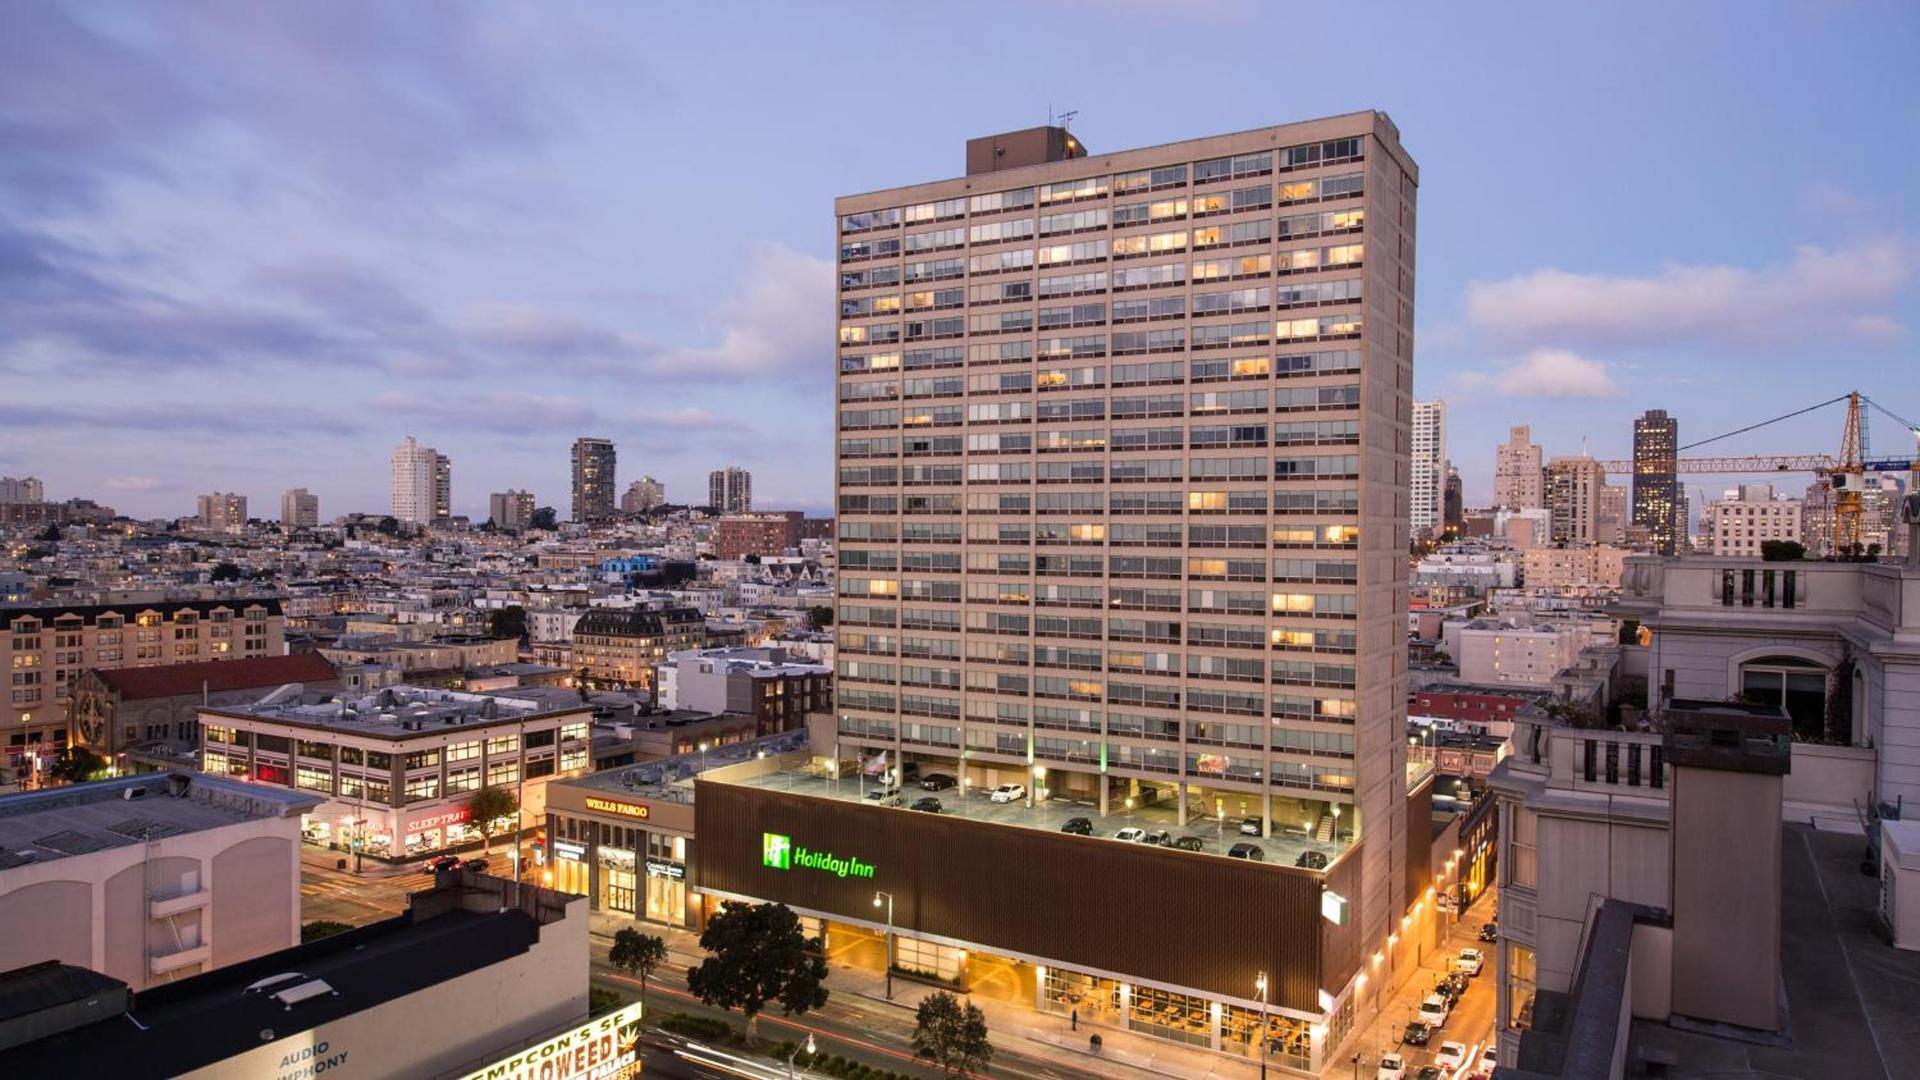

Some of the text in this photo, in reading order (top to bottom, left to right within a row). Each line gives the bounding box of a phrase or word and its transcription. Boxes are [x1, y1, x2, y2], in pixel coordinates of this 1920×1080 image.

[586, 798, 648, 818] WELLS FARGO
[408, 817, 440, 832] SLEEP
[795, 847, 875, 878] Holiday Inn
[600, 1014, 625, 1028] SF
[277, 1051, 348, 1080] MPHONY
[280, 1042, 329, 1068] AUDIO
